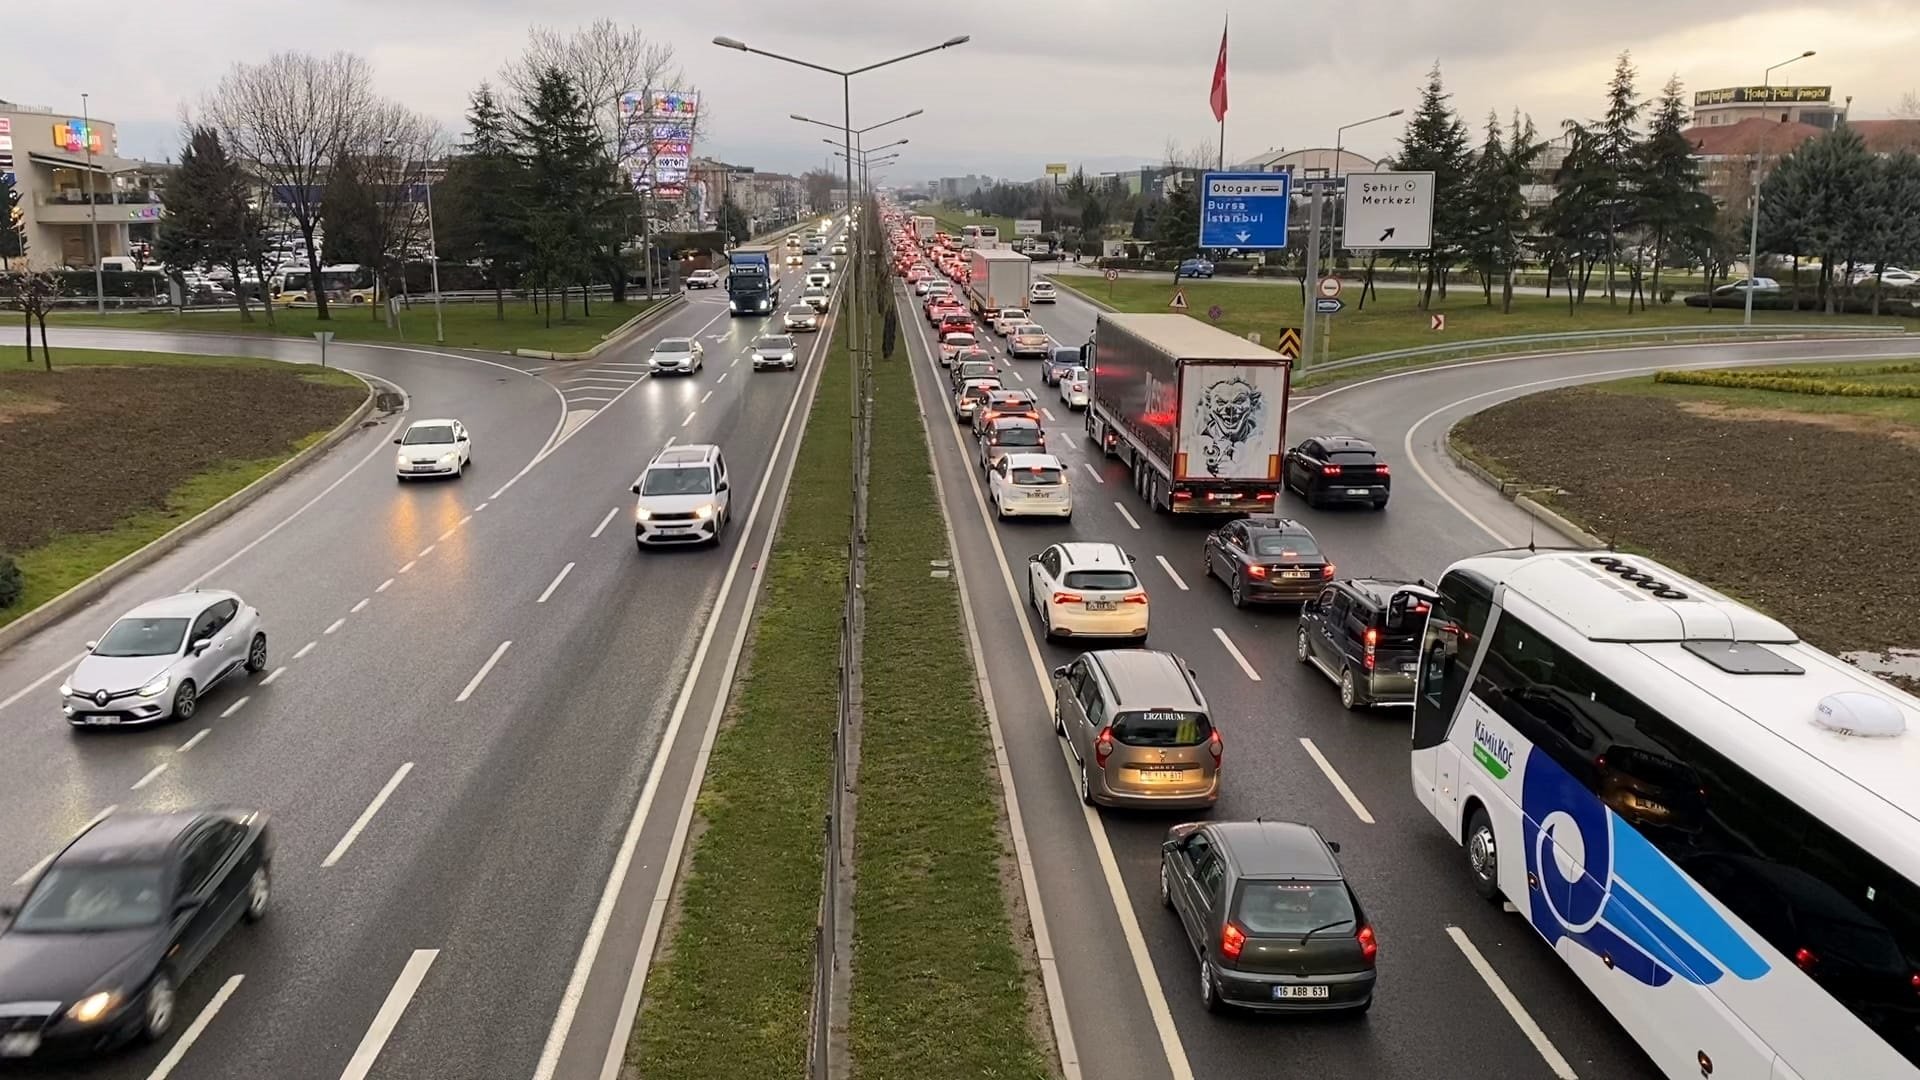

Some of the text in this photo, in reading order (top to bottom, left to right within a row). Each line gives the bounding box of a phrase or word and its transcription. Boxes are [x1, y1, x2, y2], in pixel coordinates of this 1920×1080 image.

[1213, 184, 1257, 194] Otogar
[1363, 183, 1399, 193] Şehir
[1208, 200, 1245, 210] Bursa
[1279, 986, 1327, 997] 16 ABB 631
